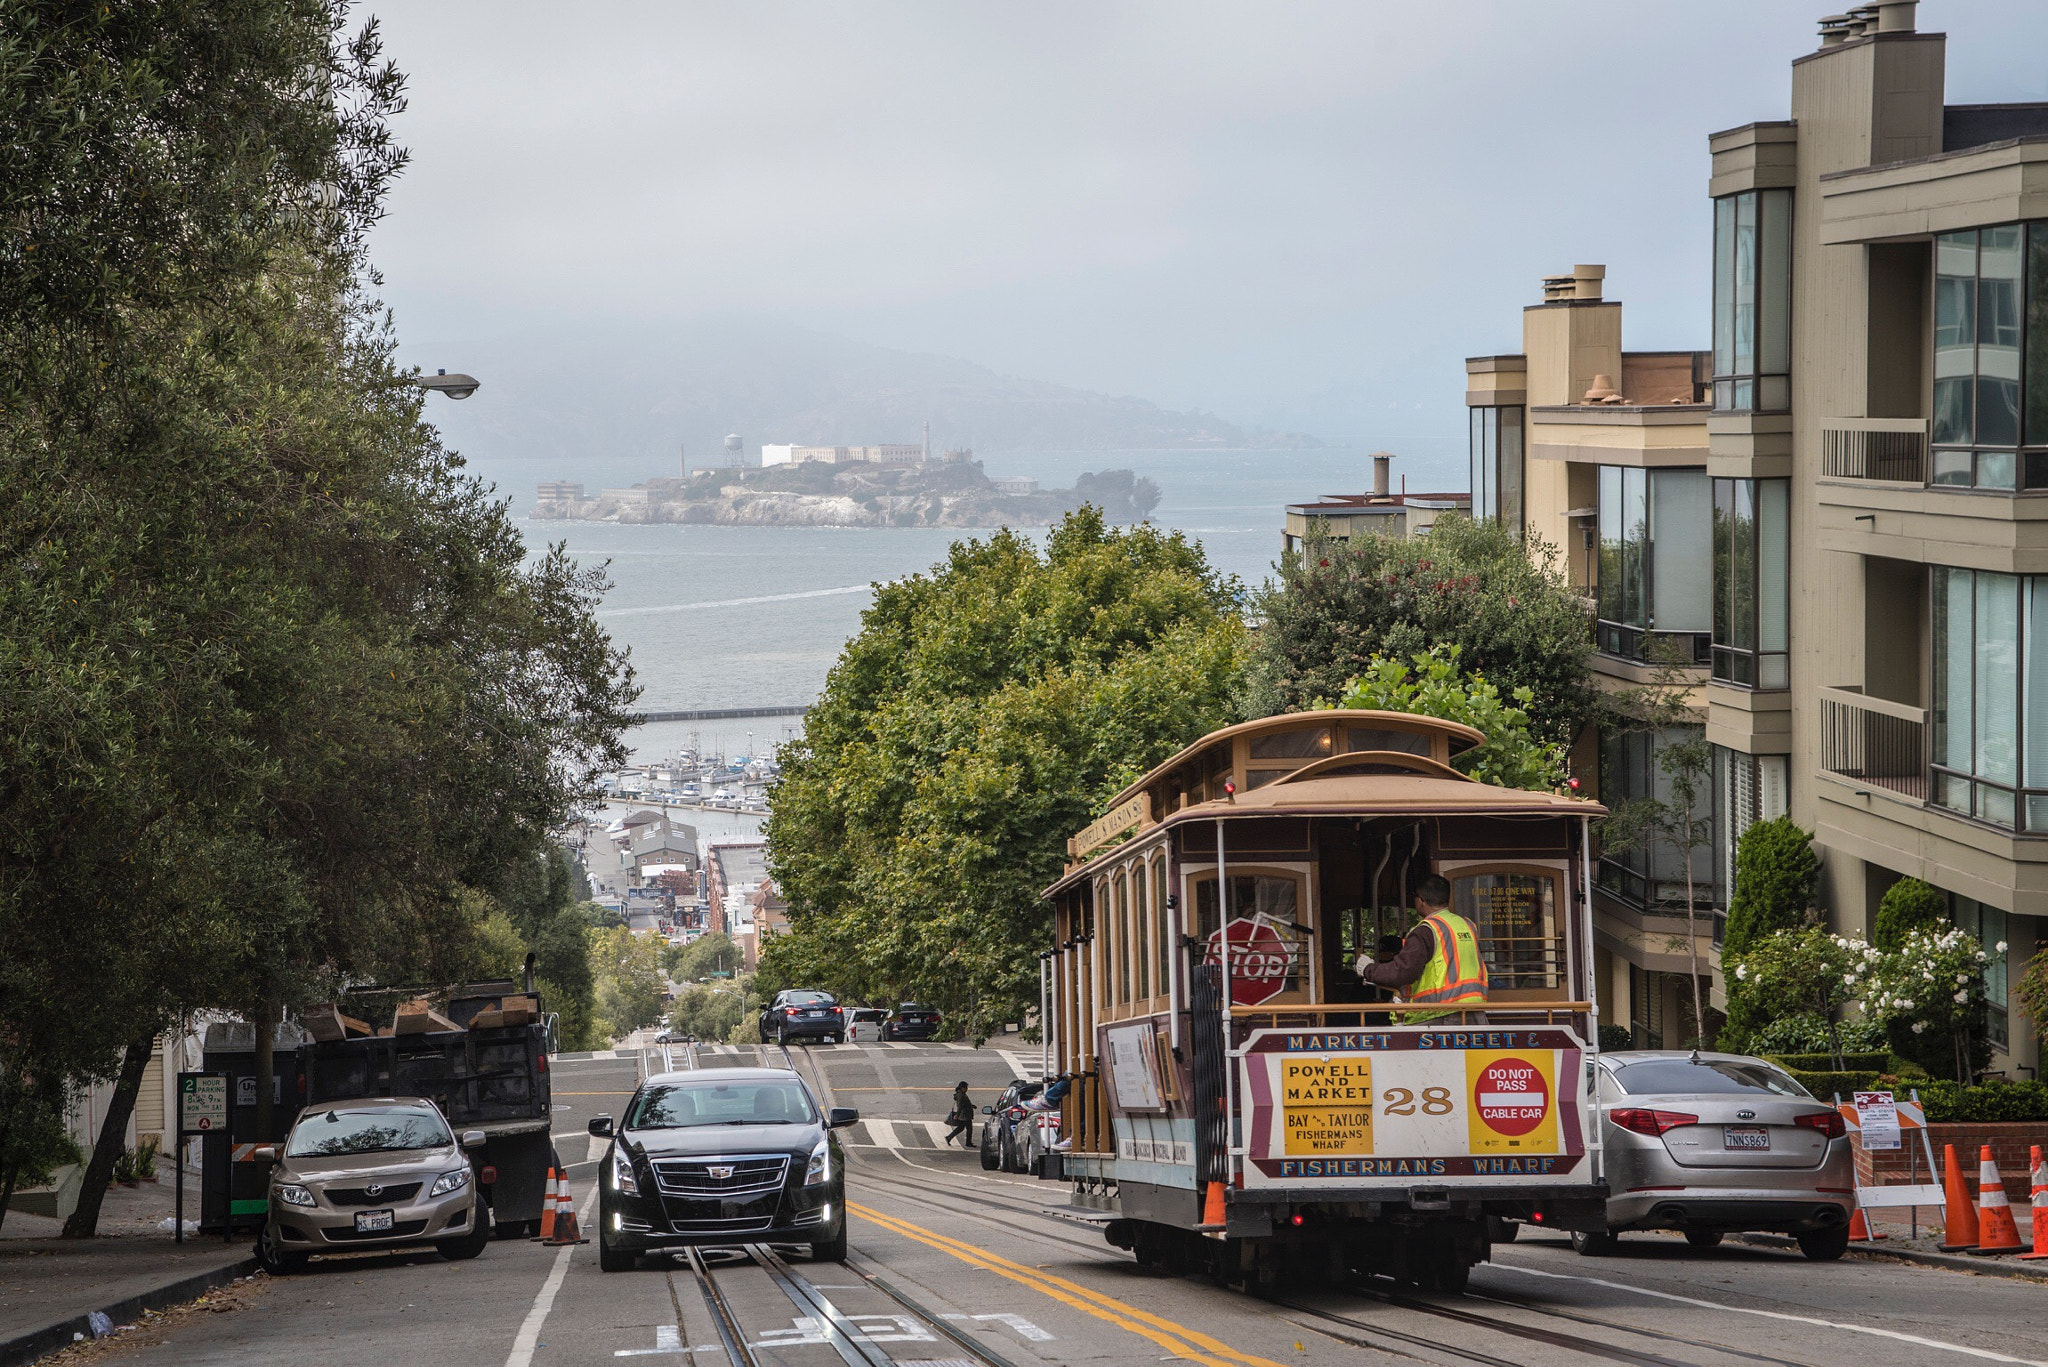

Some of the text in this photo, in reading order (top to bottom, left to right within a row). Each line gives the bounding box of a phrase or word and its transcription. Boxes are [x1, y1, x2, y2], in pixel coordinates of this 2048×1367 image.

[1109, 805, 1132, 832] MASON
[1505, 887, 1520, 895] ONE
[1521, 887, 1536, 895] WAY
[1209, 942, 1283, 984] STOP
[1287, 1034, 1392, 1052] MARKET
[1418, 1032, 1517, 1049] STREET
[1289, 1065, 1369, 1078] POWELL
[1488, 1069, 1534, 1080] DO NOT
[185, 1079, 194, 1091] 2
[1310, 1077, 1349, 1087] AND
[1496, 1080, 1527, 1091] PASS
[1287, 1087, 1370, 1100] MARKET
[1383, 1086, 1454, 1117] 28
[1483, 1108, 1543, 1119] CABLE CAR
[1739, 1111, 1755, 1119] KIA
[1288, 1114, 1309, 1127] BAY
[1328, 1113, 1370, 1127] TAYLOR
[1296, 1130, 1363, 1140] FISHERMANS
[1726, 1134, 1767, 1147] 7NNS869
[1312, 1140, 1347, 1149] WHARF
[1280, 1157, 1555, 1177] FISHERMANS WHARF
[371, 1216, 391, 1228] PROF
